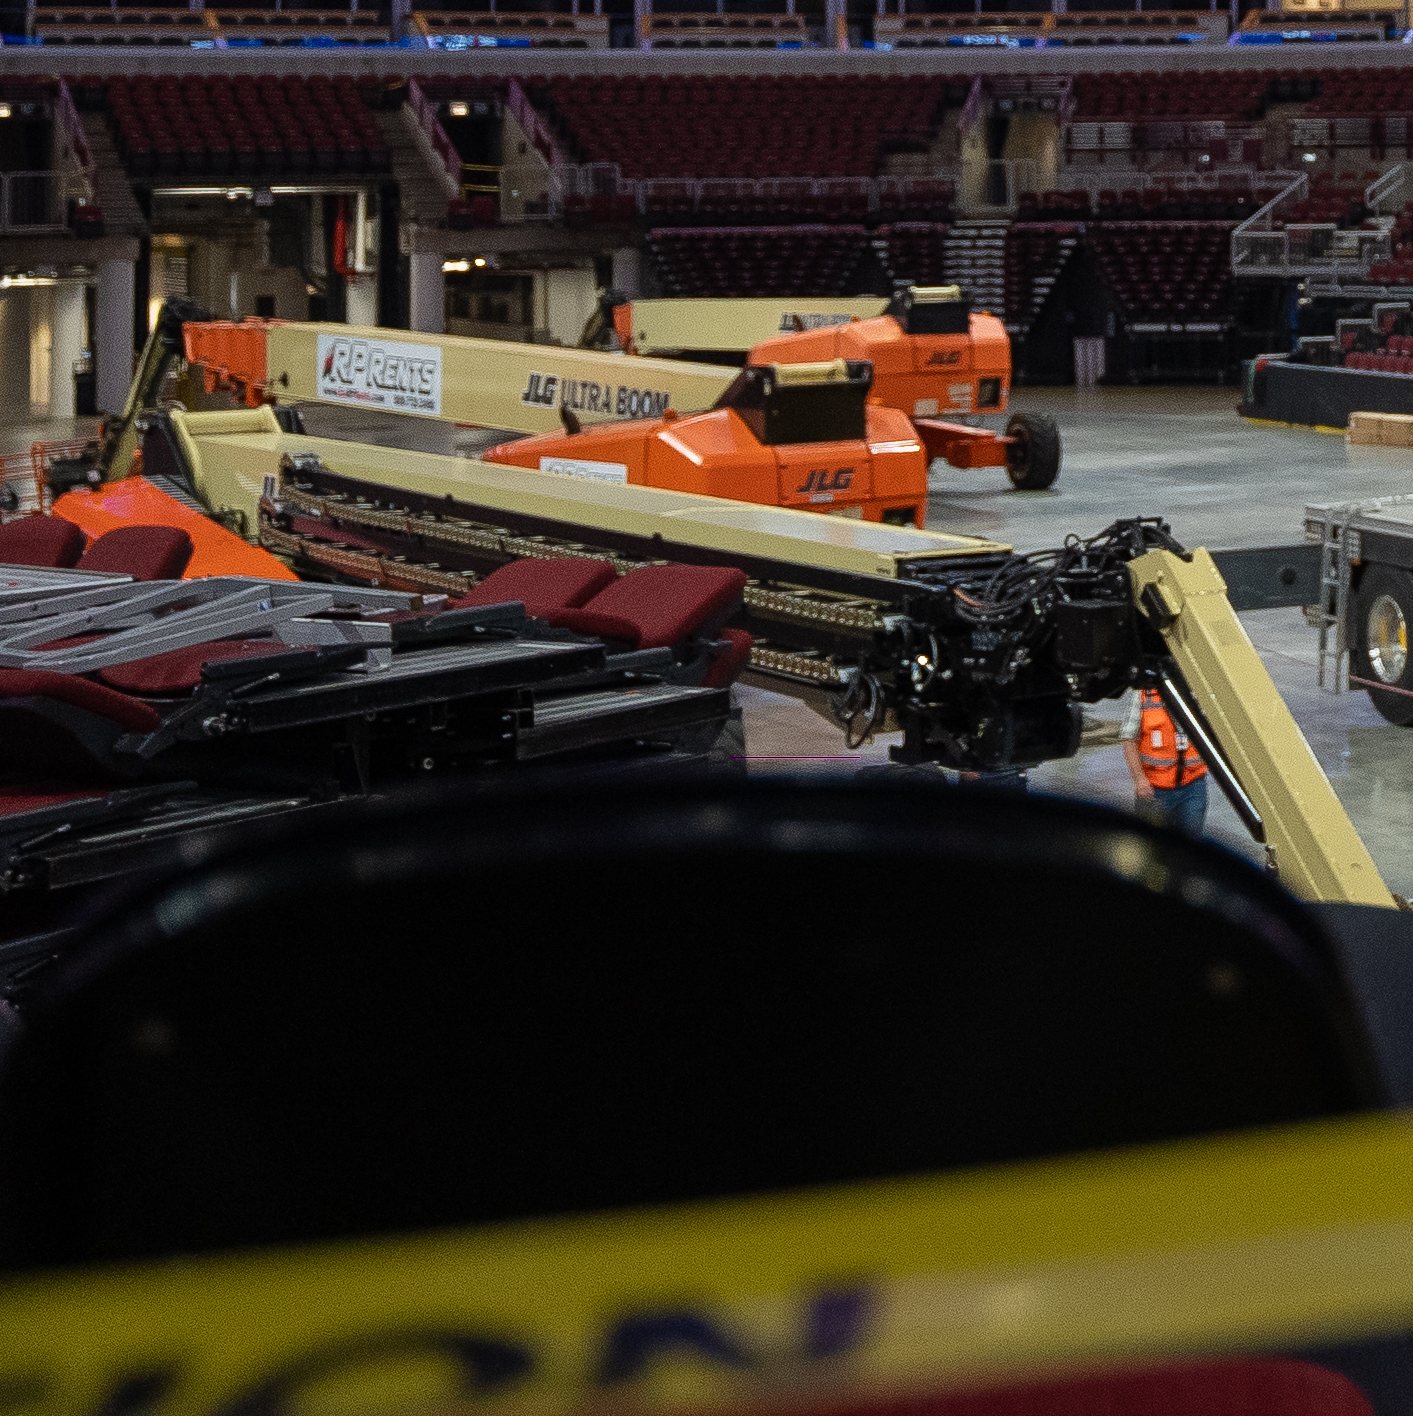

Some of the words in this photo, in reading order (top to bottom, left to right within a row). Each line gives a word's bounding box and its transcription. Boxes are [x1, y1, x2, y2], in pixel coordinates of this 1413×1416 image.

[522, 372, 557, 406] JLG
[561, 378, 611, 413] ULTRA
[616, 385, 671, 419] BOOM
[796, 466, 855, 494] JLG
